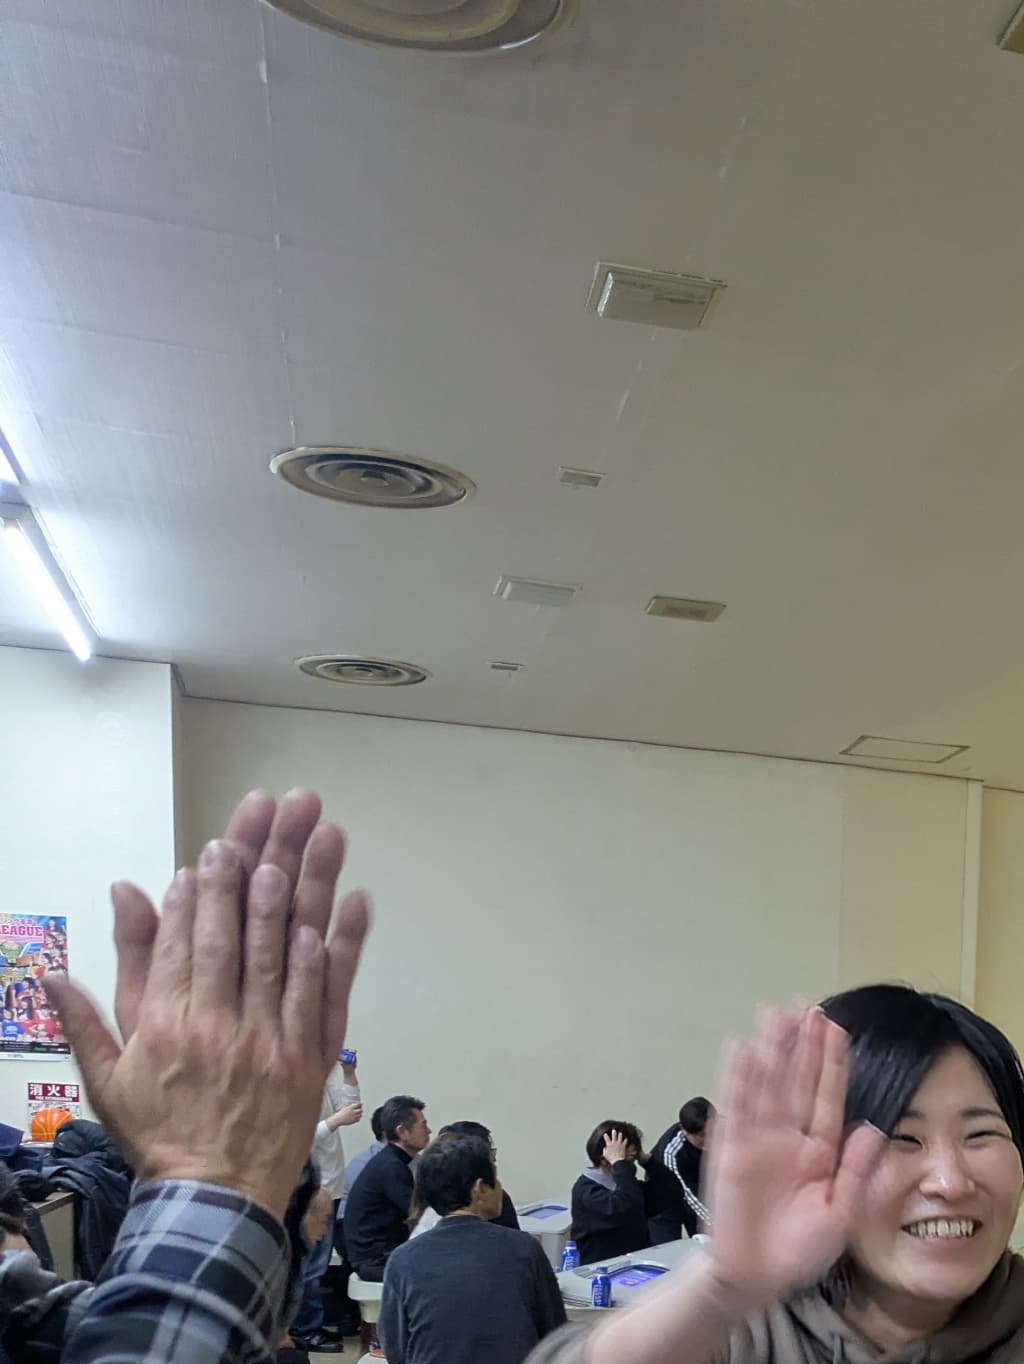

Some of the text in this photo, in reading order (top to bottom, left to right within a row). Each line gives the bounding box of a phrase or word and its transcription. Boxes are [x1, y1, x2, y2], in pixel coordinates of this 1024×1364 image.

[0, 925, 43, 936] EAGUE
[29, 1084, 78, 1097] 消火器
